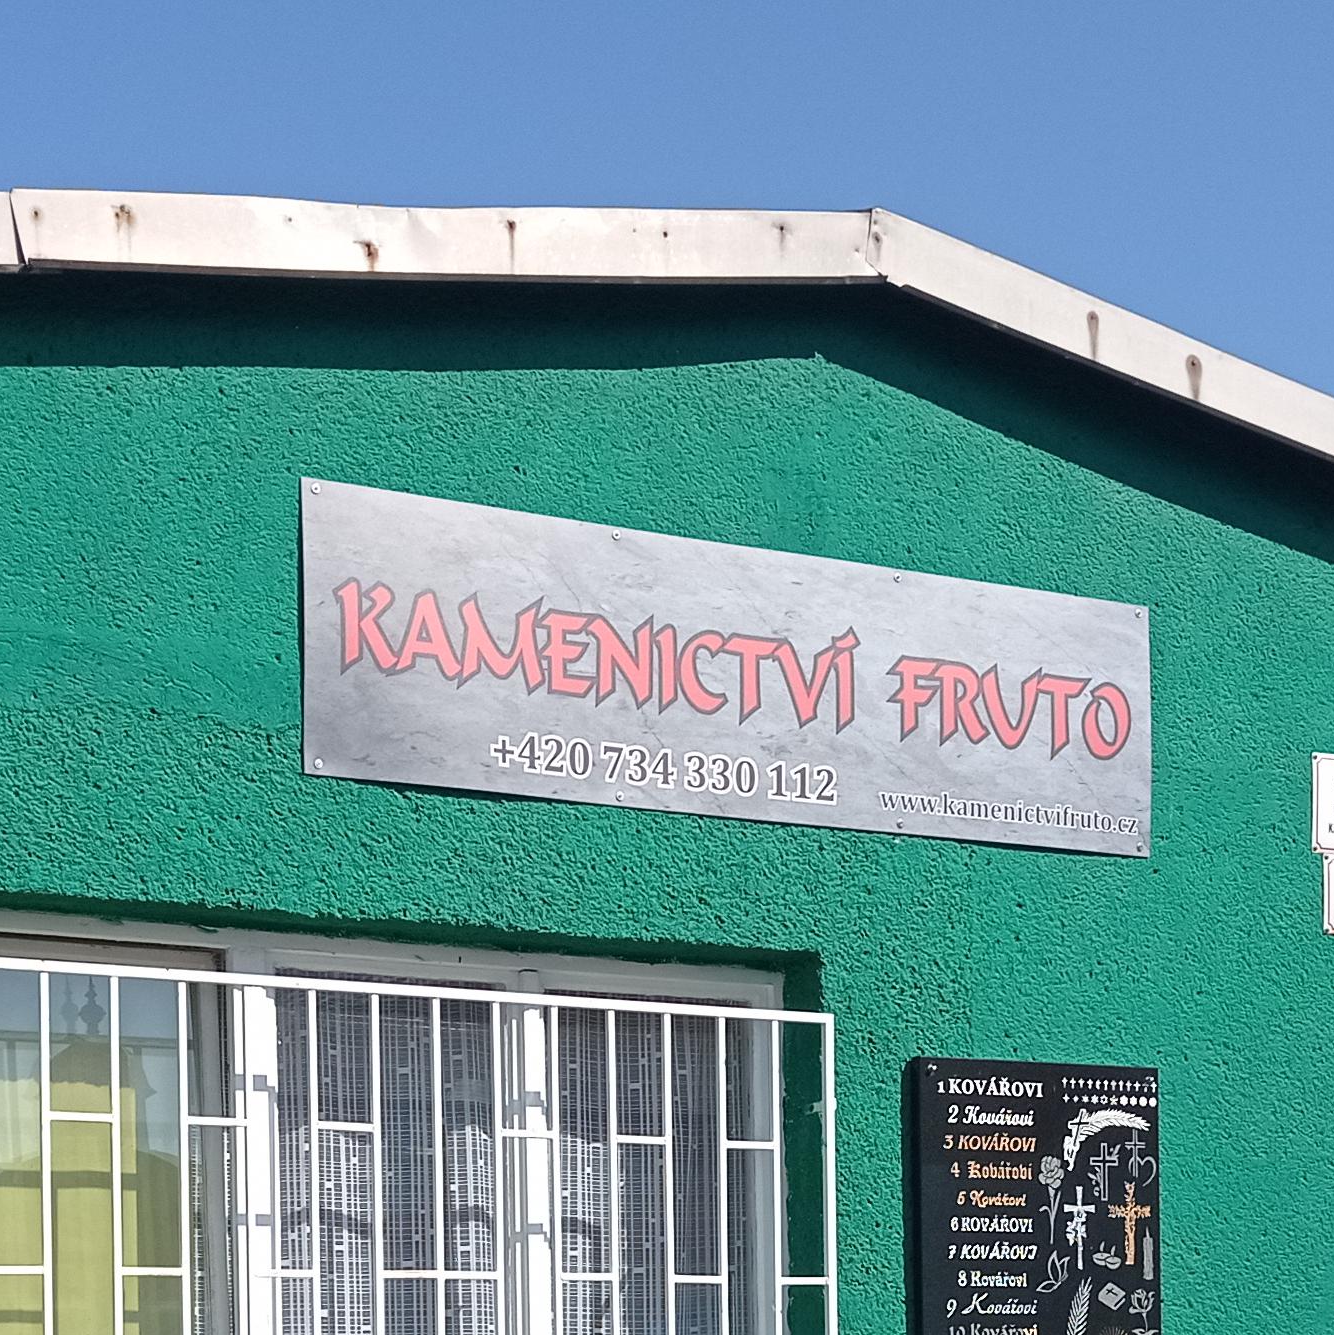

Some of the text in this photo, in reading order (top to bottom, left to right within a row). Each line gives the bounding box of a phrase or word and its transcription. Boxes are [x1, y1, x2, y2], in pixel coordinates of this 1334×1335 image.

[333, 577, 1131, 760] KAMENICTVÍ FRUTO
[492, 733, 838, 804] +420 734 330 112
[880, 792, 1138, 834] www.kamenictvifruto.cz
[948, 1077, 1043, 1098] KOVÁŘOVI
[947, 1104, 1034, 1127] 2 Kovářovi
[942, 1132, 1037, 1152] 3 KOVÁŘOVI
[950, 1161, 961, 1178] 4
[957, 1191, 967, 1205] 5
[950, 1215, 1034, 1232] 6 KOVÁŘOVI
[948, 1241, 1038, 1260] 7 KOVÁŘOVI
[958, 1270, 1028, 1287] 8 Kovářovi
[946, 1293, 1038, 1318] 9 Kovářovi
